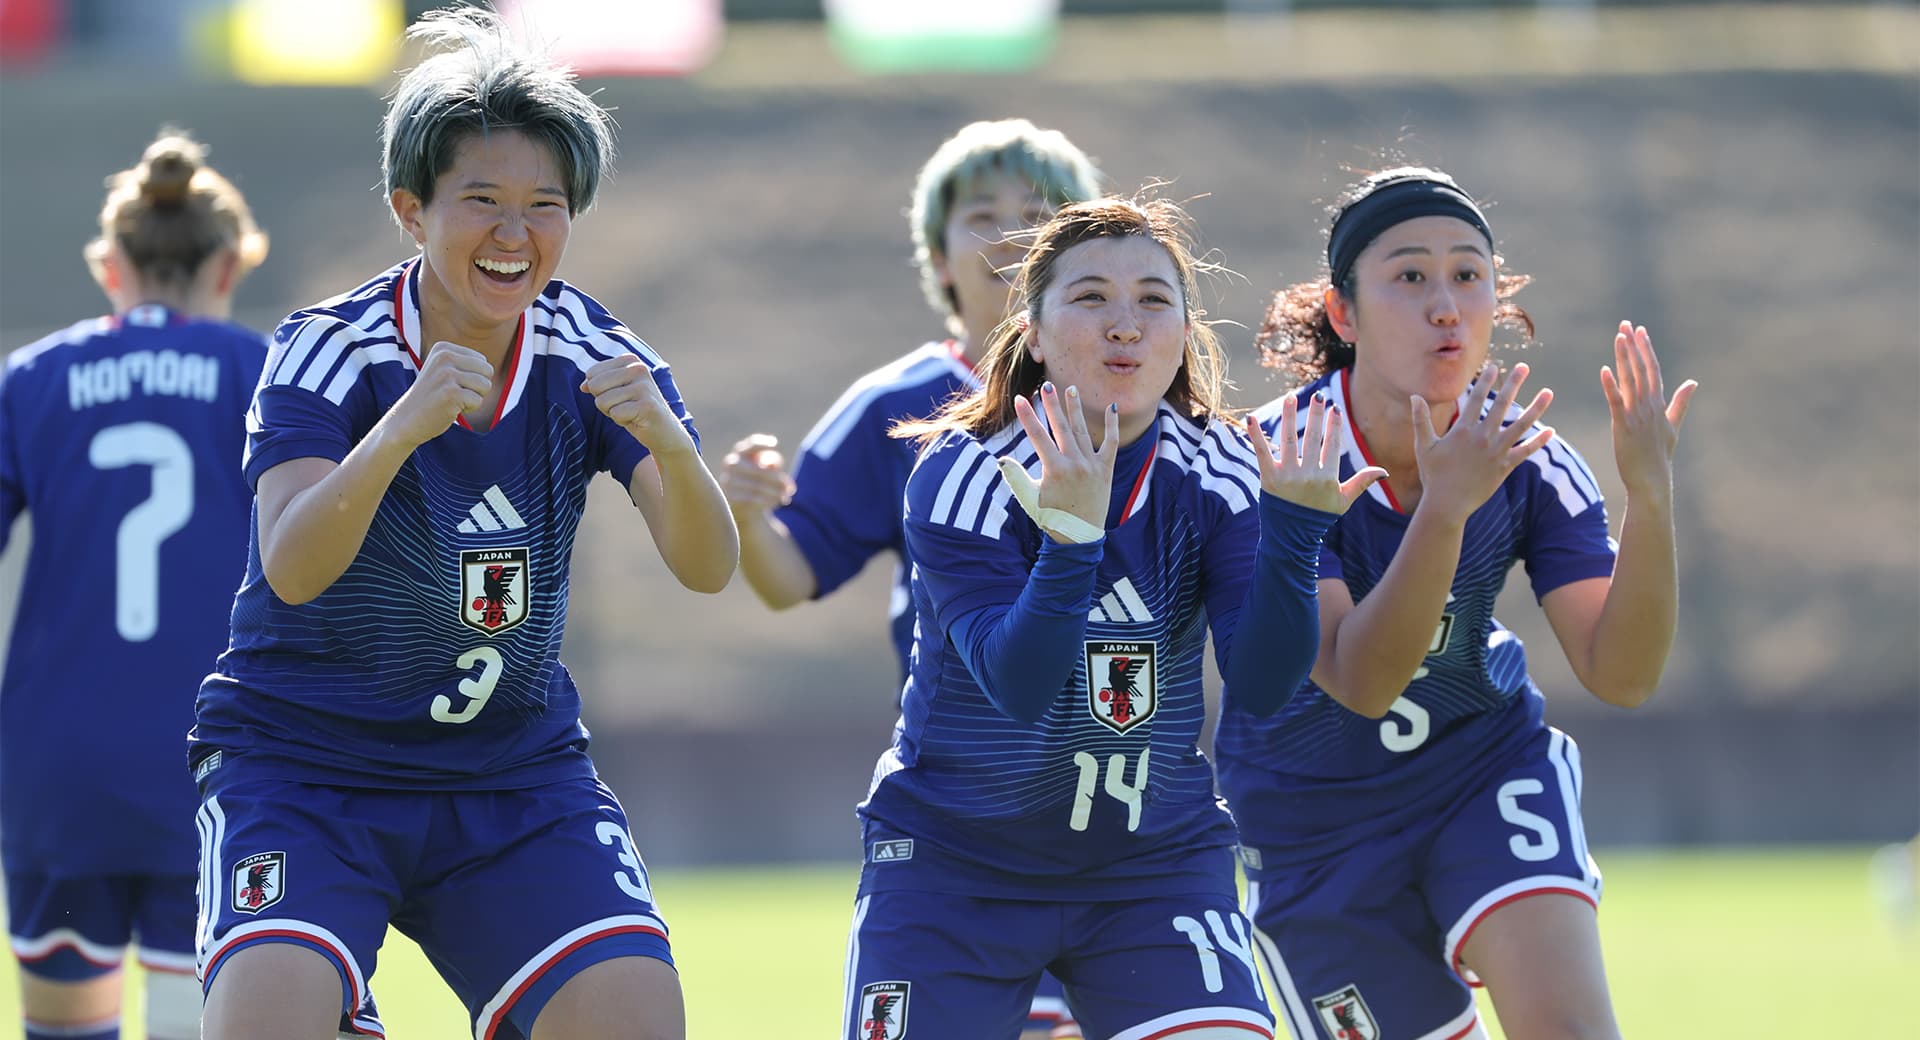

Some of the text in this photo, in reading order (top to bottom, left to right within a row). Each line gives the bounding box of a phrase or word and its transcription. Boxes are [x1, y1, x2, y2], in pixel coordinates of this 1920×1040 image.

[69, 349, 218, 411] KOMORI
[89, 421, 195, 642] 7
[477, 552, 512, 561] JAPAN
[478, 611, 508, 623] JFA
[1102, 644, 1138, 652] JAPAN
[430, 646, 503, 724] 3
[1106, 703, 1137, 718] JFA
[1069, 747, 1150, 832] 14
[1496, 778, 1560, 861] 5
[244, 854, 272, 865] JAPAN
[594, 821, 652, 903] 3
[244, 893, 267, 906] JFA
[1172, 910, 1264, 1002] 14
[870, 984, 897, 992] JAPAN
